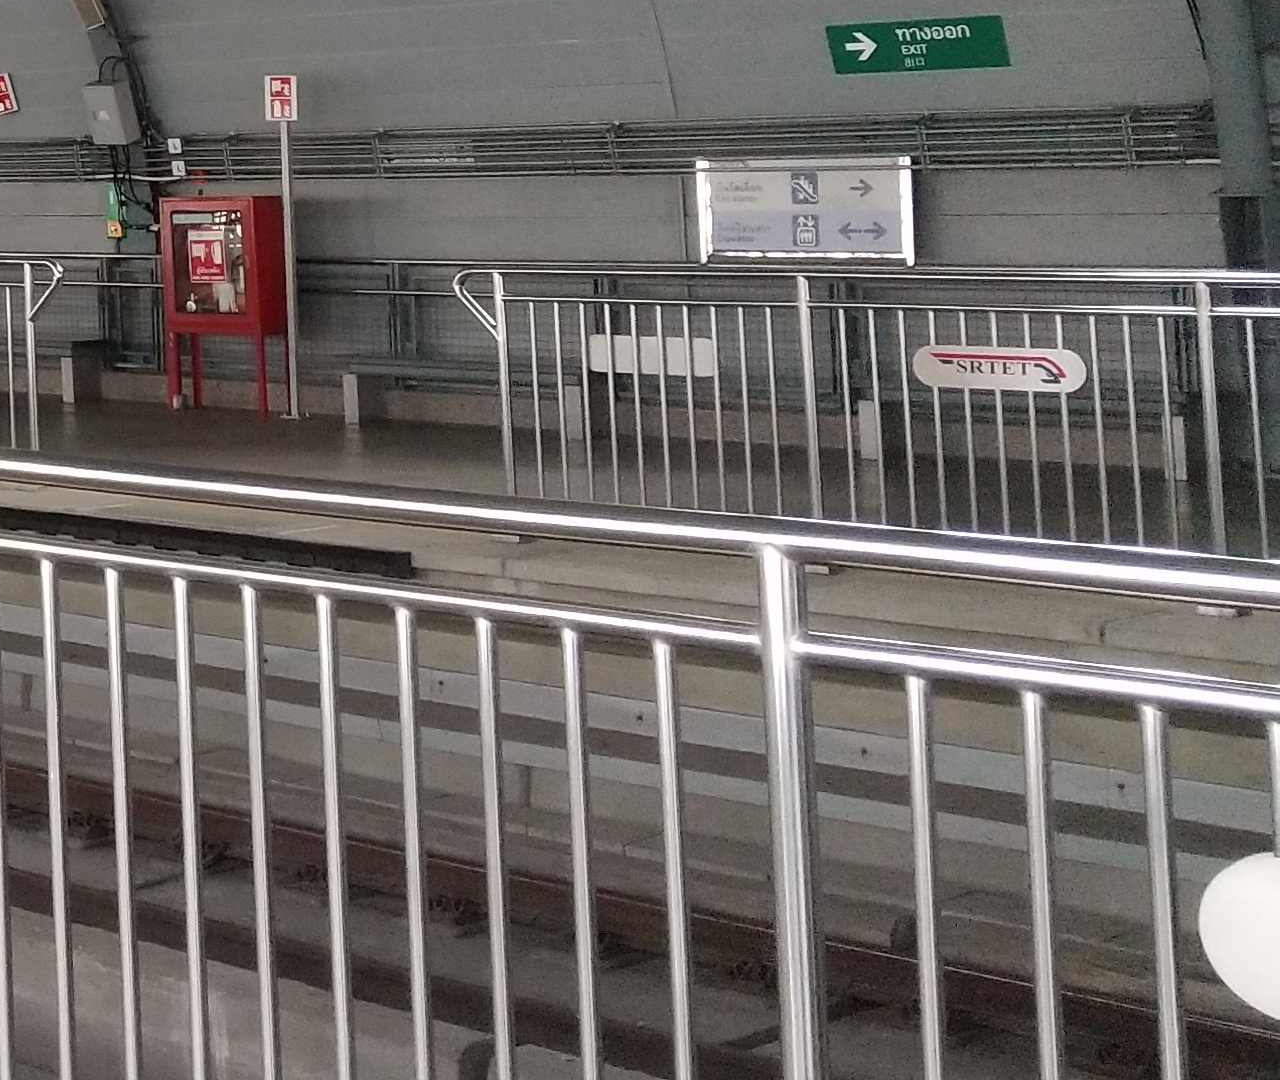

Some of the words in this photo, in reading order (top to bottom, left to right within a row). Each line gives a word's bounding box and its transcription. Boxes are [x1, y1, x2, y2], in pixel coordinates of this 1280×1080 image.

[894, 24, 971, 42] ทางออก
[901, 43, 928, 55] EXIT
[956, 359, 1031, 376] SRTET
